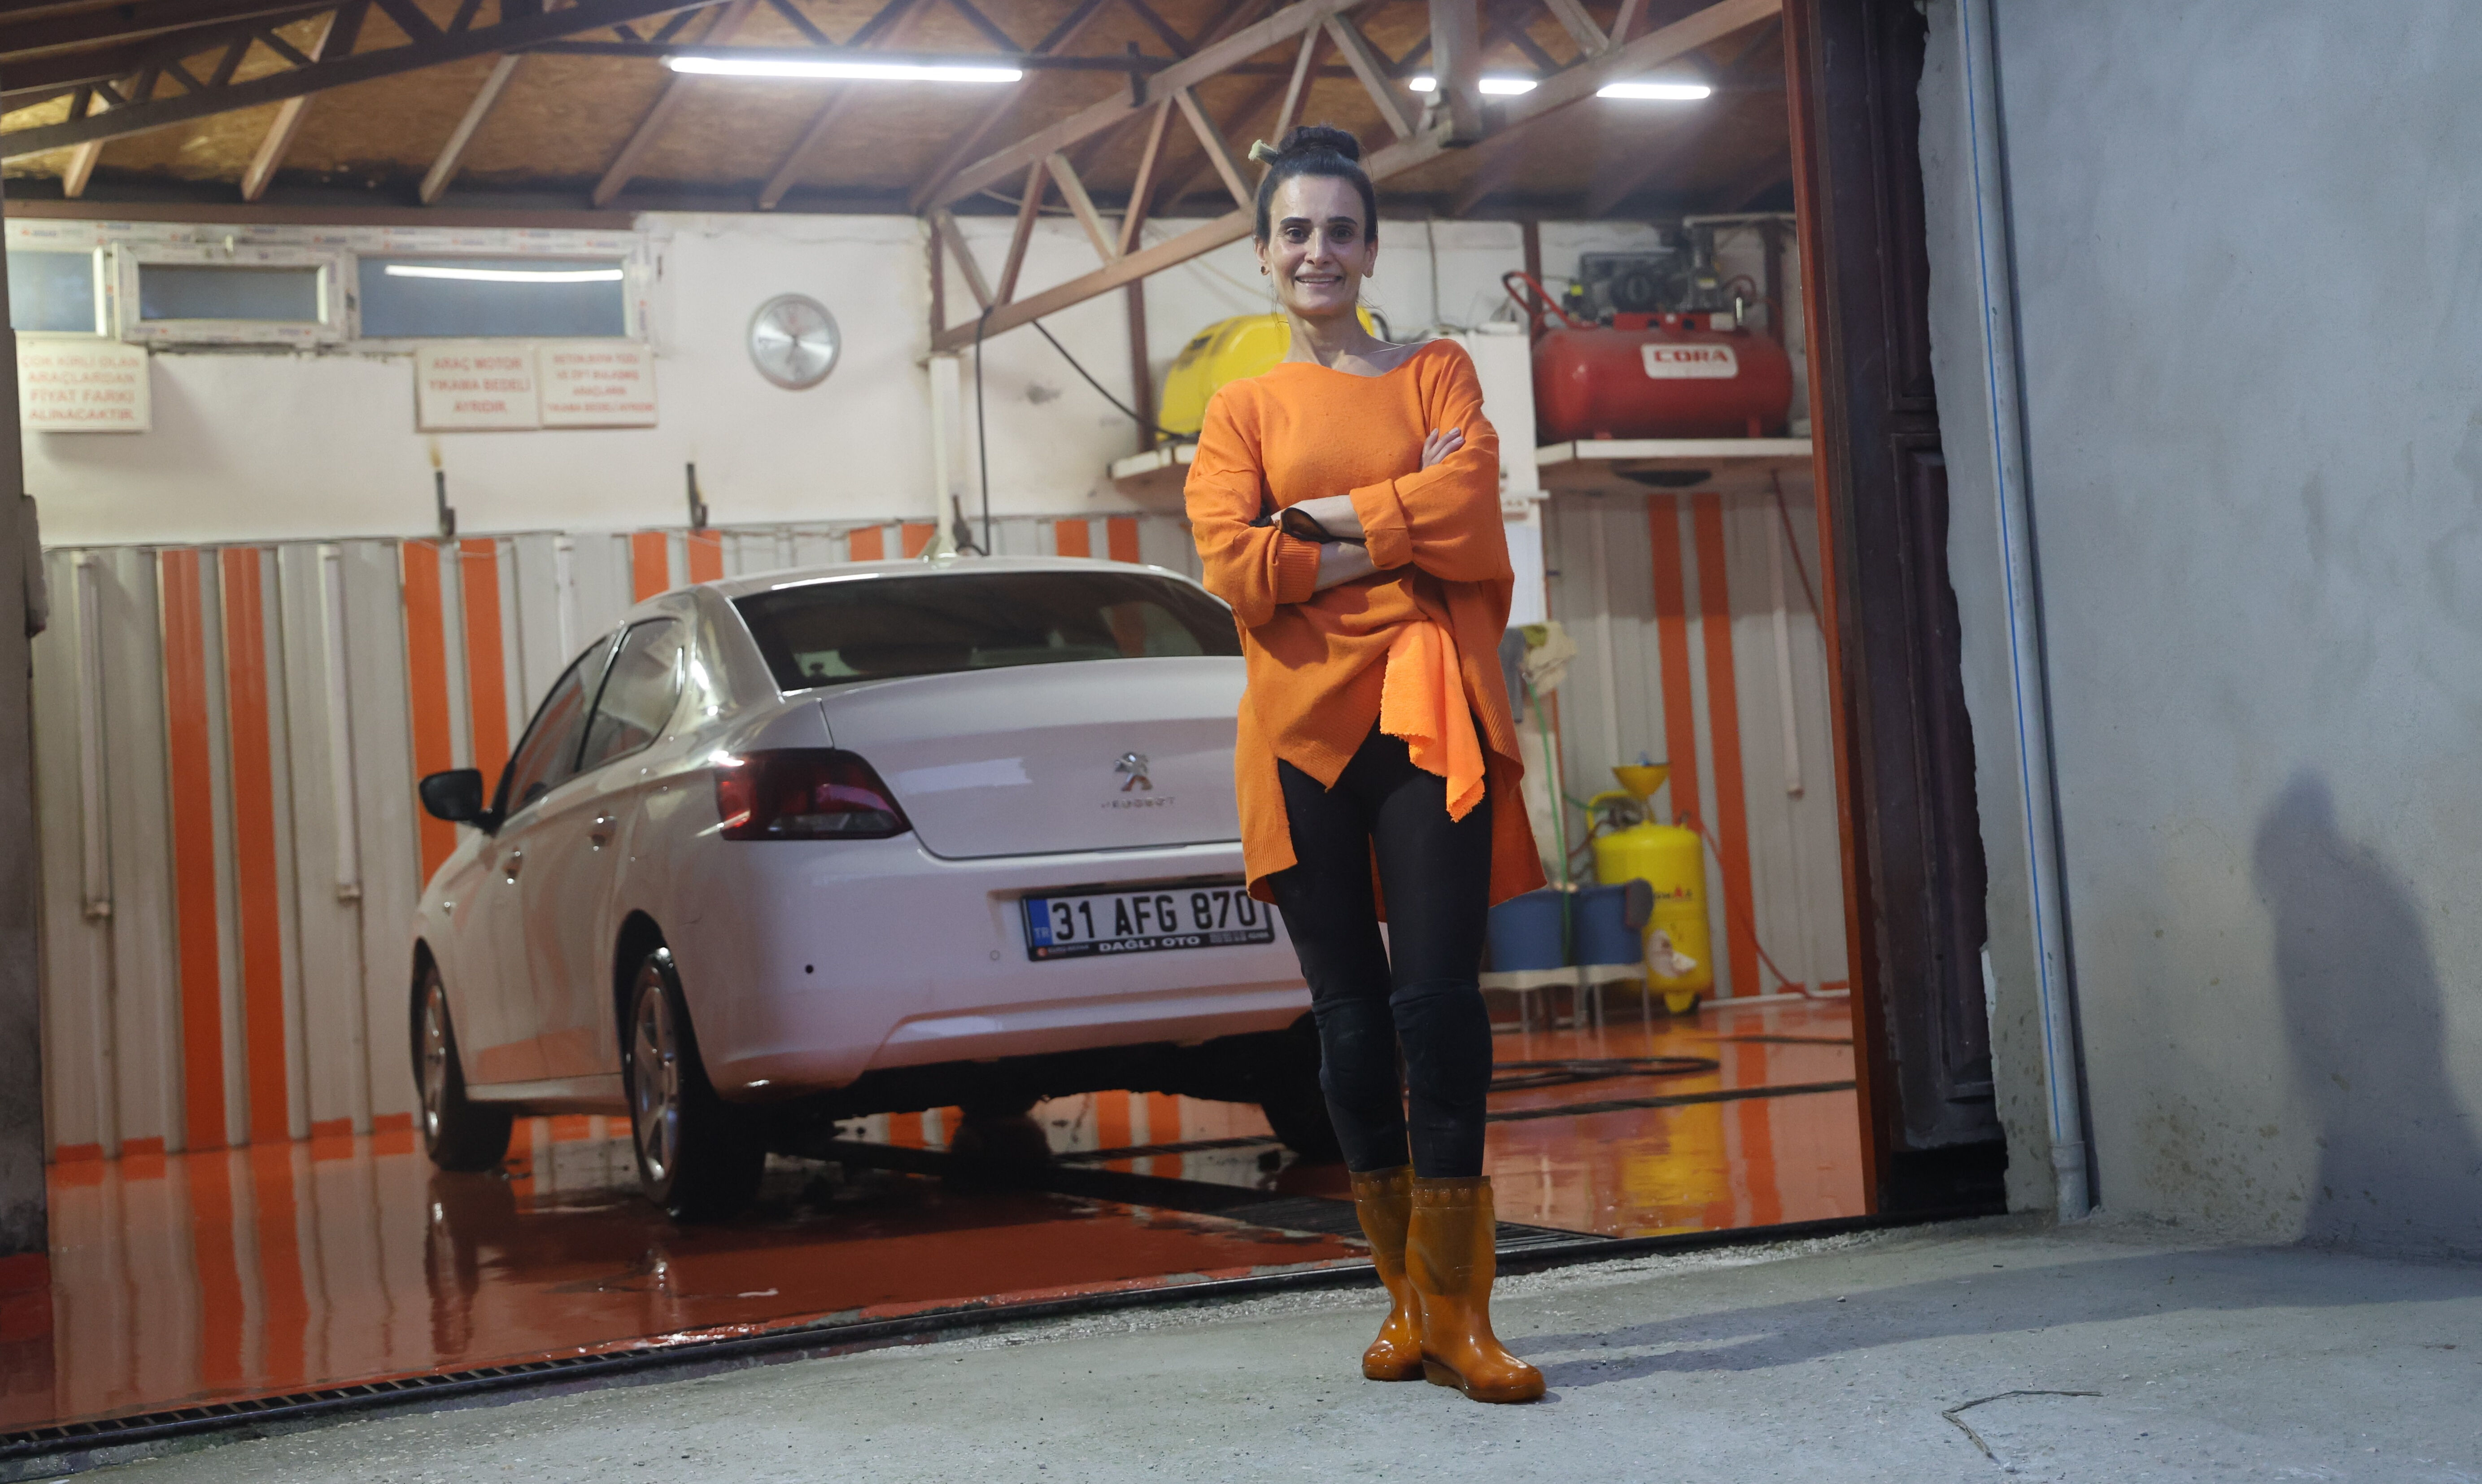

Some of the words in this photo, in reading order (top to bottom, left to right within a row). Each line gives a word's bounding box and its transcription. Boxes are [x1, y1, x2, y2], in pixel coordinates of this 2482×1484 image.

[1654, 350, 1729, 363] CORA
[1052, 901, 1095, 940] 31
[1115, 895, 1177, 935] AFG
[1191, 890, 1256, 930] 870
[1034, 927, 1049, 938] TR
[1161, 936, 1200, 946] OTO
